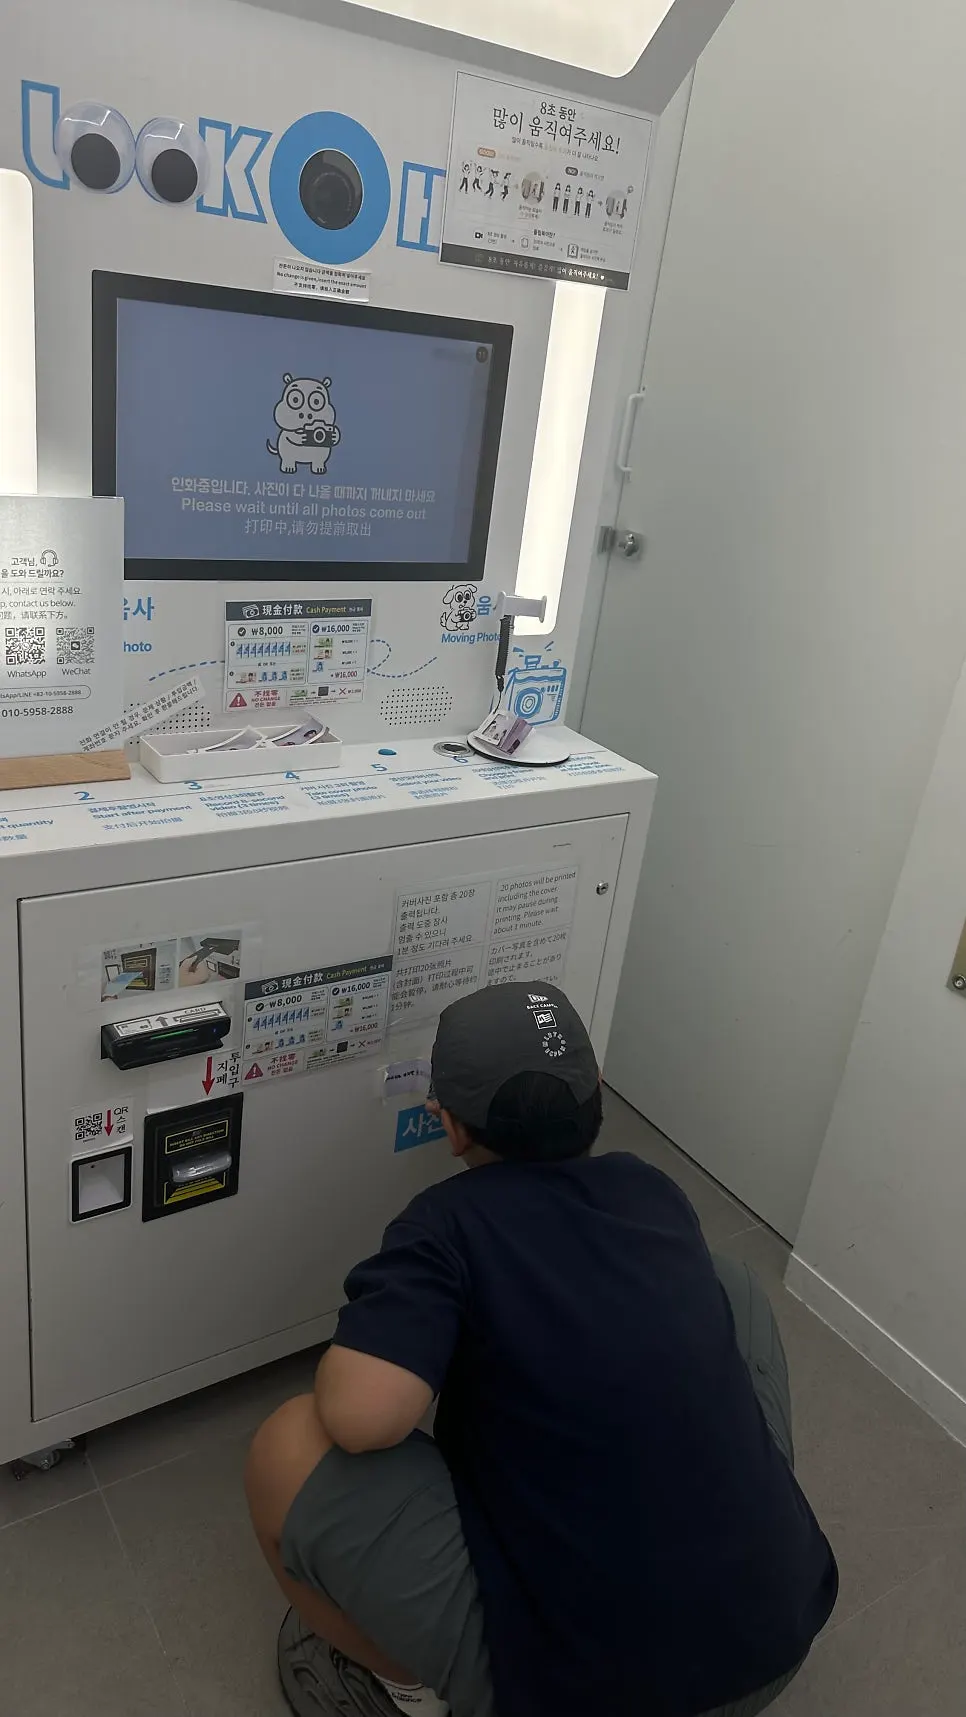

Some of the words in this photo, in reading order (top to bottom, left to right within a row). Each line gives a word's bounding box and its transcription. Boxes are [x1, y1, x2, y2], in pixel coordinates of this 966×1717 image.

[540, 101, 556, 116] 8초
[558, 106, 577, 122] 동안
[493, 107, 523, 134] 많이
[528, 115, 621, 155] 움직여주세요!
[171, 476, 250, 496] 인화중입니다.
[253, 480, 290, 498] 사진이
[293, 483, 305, 498] 다
[308, 483, 331, 499] 나올
[334, 485, 367, 501] 때까지
[370, 487, 403, 503] 꺼내지
[404, 489, 436, 504] 마세요
[181, 497, 232, 513] Please
[235, 501, 266, 514] wait
[268, 502, 299, 516] until
[302, 502, 318, 517] all
[321, 504, 366, 520] photos
[369, 508, 404, 519] come
[406, 507, 426, 520] out
[11, 557, 38, 567] 고객님,
[10, 569, 27, 578] 도와
[27, 569, 65, 579] 드릴까요?
[2, 586, 12, 596] 시,
[13, 586, 38, 595] 아래로
[39, 586, 55, 596] 연락
[56, 586, 82, 595] 주세요
[9, 600, 39, 608] contact
[50, 599, 76, 608] below.
[262, 603, 303, 616] 現金付款
[306, 606, 321, 614] Cash
[321, 605, 347, 615] Payment
[251, 626, 283, 636] ₩8,000
[321, 624, 350, 634] ₩16,000
[441, 632, 476, 645] Moving
[7, 670, 47, 679] WhatsApp
[61, 667, 91, 676] WeChat
[2, 705, 73, 718] 010-5958-2888
[371, 763, 388, 773] 5
[284, 771, 301, 780] 4
[183, 780, 203, 790] 3
[73, 790, 96, 801] 2
[92, 811, 120, 819] Start
[121, 809, 146, 817] after
[147, 803, 193, 817] payment
[7, 818, 54, 829] quantity
[500, 883, 509, 892] 20
[509, 880, 532, 892] photos
[533, 876, 545, 886] will
[545, 875, 554, 884] be
[554, 871, 576, 883] printed
[401, 895, 432, 908] 커버사진
[432, 893, 448, 903] 포함
[459, 888, 475, 899] 20장
[497, 891, 529, 904] including
[529, 888, 540, 897] the
[502, 902, 518, 912] may
[517, 899, 538, 910] pause
[537, 895, 559, 906] during
[400, 905, 440, 920] 출력됩니다.
[523, 909, 545, 919] Please
[545, 905, 559, 914] wait
[399, 921, 415, 932] 출력
[416, 919, 431, 929] 도중
[433, 916, 448, 927] 잠시
[493, 924, 513, 935] about
[415, 932, 421, 940] 수
[410, 943, 426, 954] 정도
[450, 934, 473, 945] 주세요
[326, 972, 341, 980] Cash
[342, 965, 368, 977] Payment
[282, 971, 324, 989] 現金付款
[341, 981, 371, 994] ₩16,000
[269, 994, 302, 1009] ₩8,000
[215, 1061, 228, 1085] 지폐
[228, 1052, 241, 1088] 투입구
[113, 1106, 129, 1116] QR
[116, 1116, 126, 1134] 스캔
